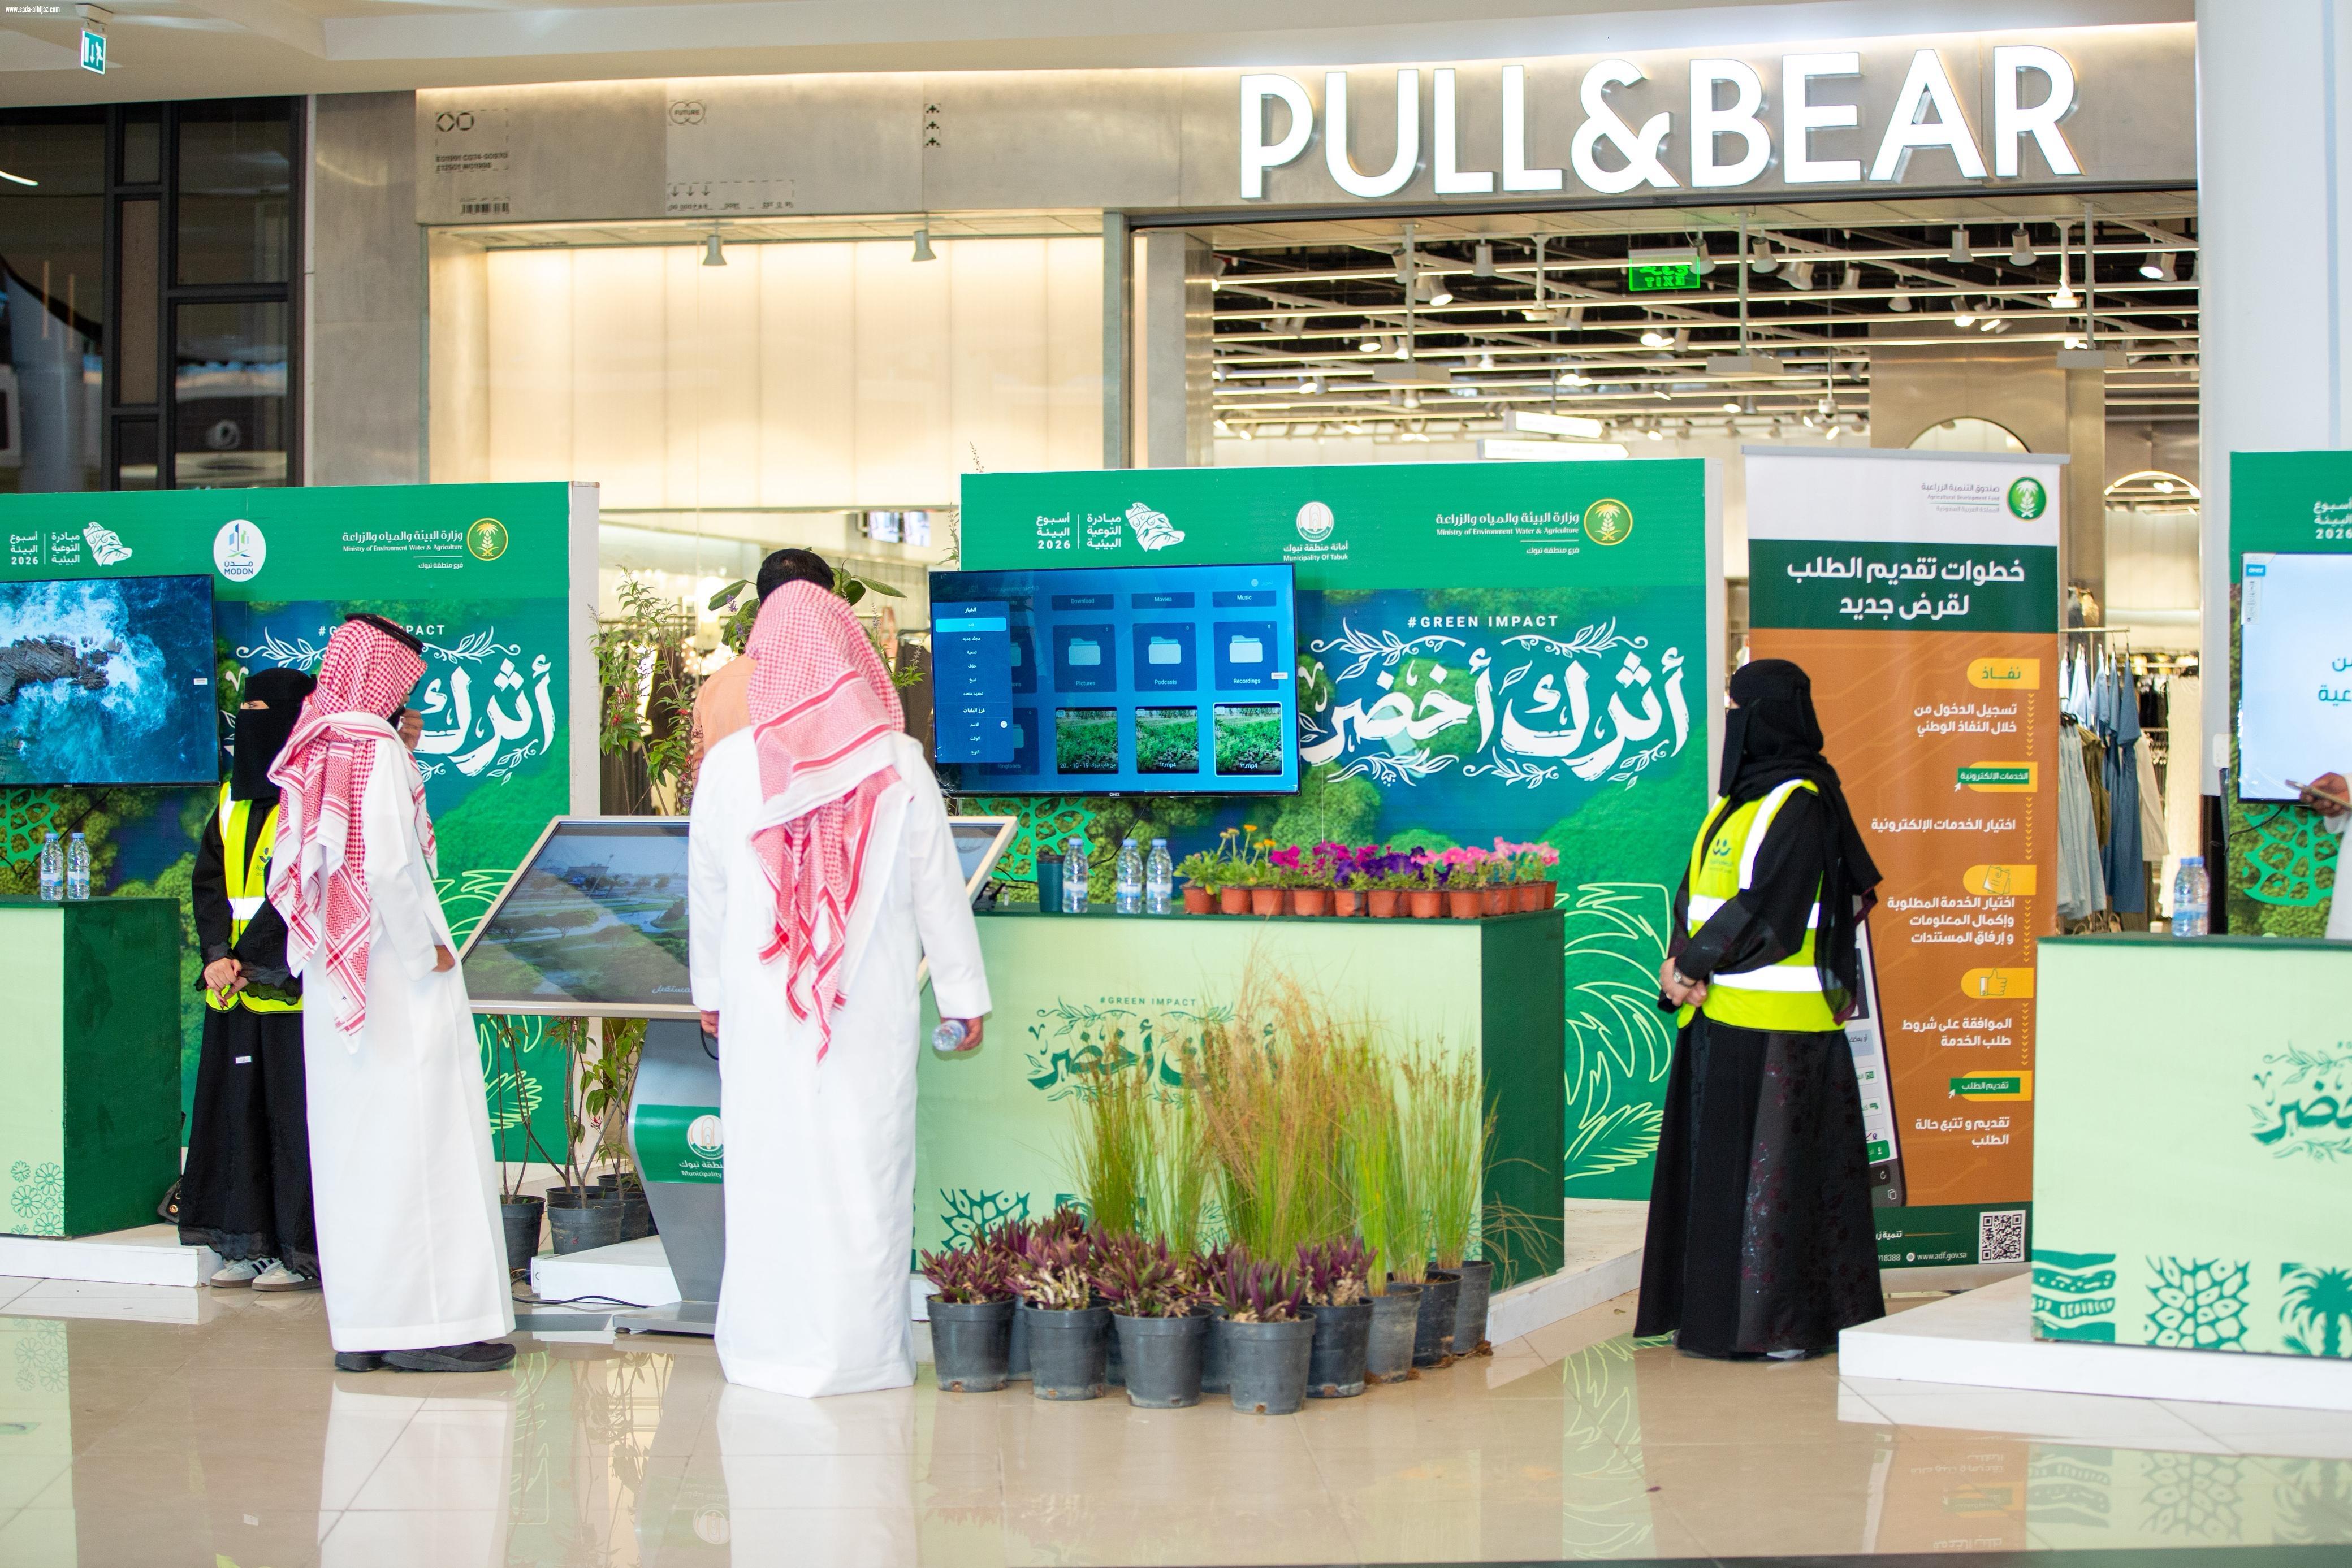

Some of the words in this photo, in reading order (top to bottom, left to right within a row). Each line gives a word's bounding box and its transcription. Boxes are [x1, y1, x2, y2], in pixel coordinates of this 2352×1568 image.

[1240, 45, 2084, 198] PULL&BEAR
[1921, 483, 1948, 492] الزراعية
[1949, 483, 1973, 492] التنمية
[1975, 484, 2000, 493] صندوق
[1036, 513, 1070, 526] أسبوع
[1087, 513, 1121, 525] مبادرة
[1436, 513, 1477, 526] والزراعة
[1479, 513, 1519, 526] والمياه
[1521, 511, 1551, 523] البيئة
[1553, 512, 1579, 525] وزارة
[10, 531, 38, 543] أسبوع
[51, 531, 80, 543] مبادرة
[343, 532, 377, 543] والزراعة
[379, 531, 412, 543] والمياه
[414, 530, 439, 541] البيئة
[441, 530, 463, 542] وزارة
[1037, 527, 1070, 538] البيئة
[1087, 526, 1121, 537] التوعية
[1544, 527, 1579, 536] Agriculture
[2315, 528, 2352, 539] 2026
[51, 544, 80, 553] التوعية
[1037, 540, 1070, 549] 2026
[1087, 538, 1121, 548] البيئية
[1283, 544, 1303, 553] تبوك
[1330, 540, 1348, 551] أمانة
[11, 545, 38, 555] البيئة
[11, 556, 38, 565] 2026
[51, 555, 80, 564] البيئية
[1787, 556, 1862, 583] الطلب
[1866, 557, 1938, 586] تقديم
[1941, 558, 2025, 586] خطوات
[1840, 595, 1893, 620] جديد
[1899, 592, 1969, 620] لقرض
[1408, 616, 1478, 628] #GREEN
[1488, 615, 1558, 627] IMPACT
[406, 625, 445, 635] PACT
[1300, 647, 1494, 767] أخضر
[1914, 706, 1931, 717] من
[1934, 703, 1974, 717] الدخول
[1976, 703, 2017, 717] تسجيل
[1501, 647, 1689, 781] أثرك
[1917, 721, 1955, 737] الوطني
[1958, 721, 1989, 733] النفاذ
[1991, 721, 2017, 735] خلال
[2000, 772, 2028, 781] الخدمات
[1871, 818, 1932, 833] الإلكترونية
[1934, 818, 1982, 830] الخدمات
[1983, 819, 2016, 833] اختيار
[1887, 896, 1938, 911] المطلوبة
[1941, 897, 1981, 908] الخدمة
[1982, 897, 2014, 911] اختيار
[1909, 914, 1970, 927] المعلومات
[1972, 915, 2014, 928] وإكمال
[1911, 932, 1972, 943] المستندات
[1974, 932, 2004, 945] إرفاق
[1152, 998, 1196, 1006] IMPACT
[1901, 1016, 1937, 1032] شروط
[1939, 1018, 1960, 1031] على
[1962, 1017, 2012, 1031] الموافقة
[1940, 1035, 1981, 1047] الخدمة
[1982, 1036, 2011, 1049] طلب
[1961, 1082, 1986, 1090] الطلب
[1986, 1081, 2009, 1090] تقديم
[1915, 1119, 1938, 1130] حالة
[1940, 1117, 1963, 1132] تتبع
[1965, 1120, 1971, 1130] و
[1973, 1116, 2010, 1130] تقديم
[1971, 1134, 2009, 1148] الطلب
[679, 1160, 699, 1169] تبوك
[702, 1160, 724, 1169] نطقة
[681, 1170, 722, 1179] Municipality
[1883, 1230, 1903, 1240] تنمية
[1917, 1251, 1967, 1261] www.adf.gov.sa
